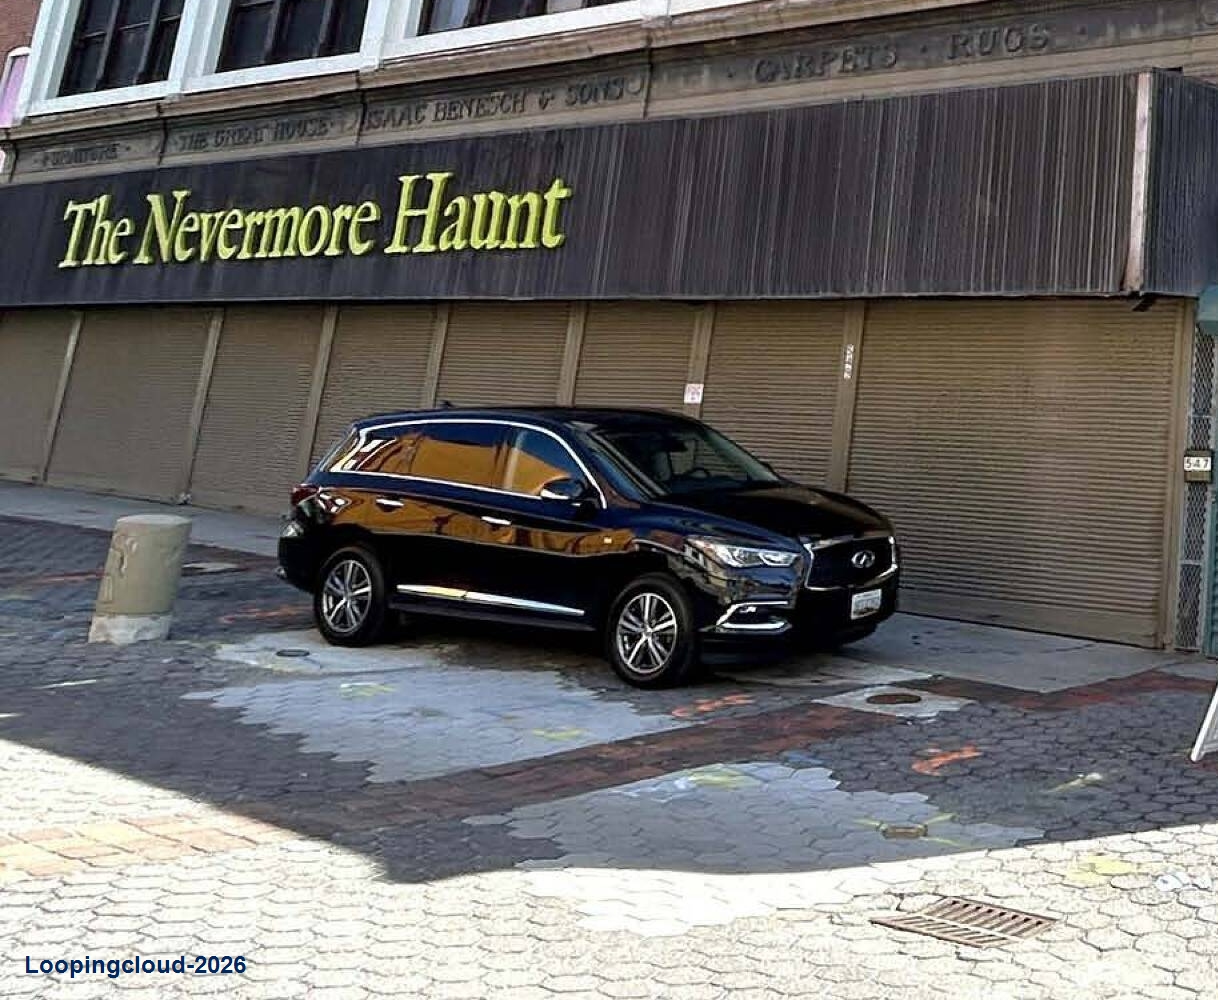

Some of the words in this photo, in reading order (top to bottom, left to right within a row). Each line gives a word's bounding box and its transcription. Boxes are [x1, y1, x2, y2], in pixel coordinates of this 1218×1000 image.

[753, 46, 897, 82] CARPETS
[947, 23, 1049, 59] RUGS
[432, 92, 527, 121] BENESCH
[567, 81, 625, 107] SONS
[176, 131, 208, 151] THE
[213, 124, 267, 148] GREAT
[58, 194, 134, 268] The
[133, 189, 381, 265] Nevermore
[384, 171, 573, 255] Haunt
[1186, 457, 1209, 470] 547
